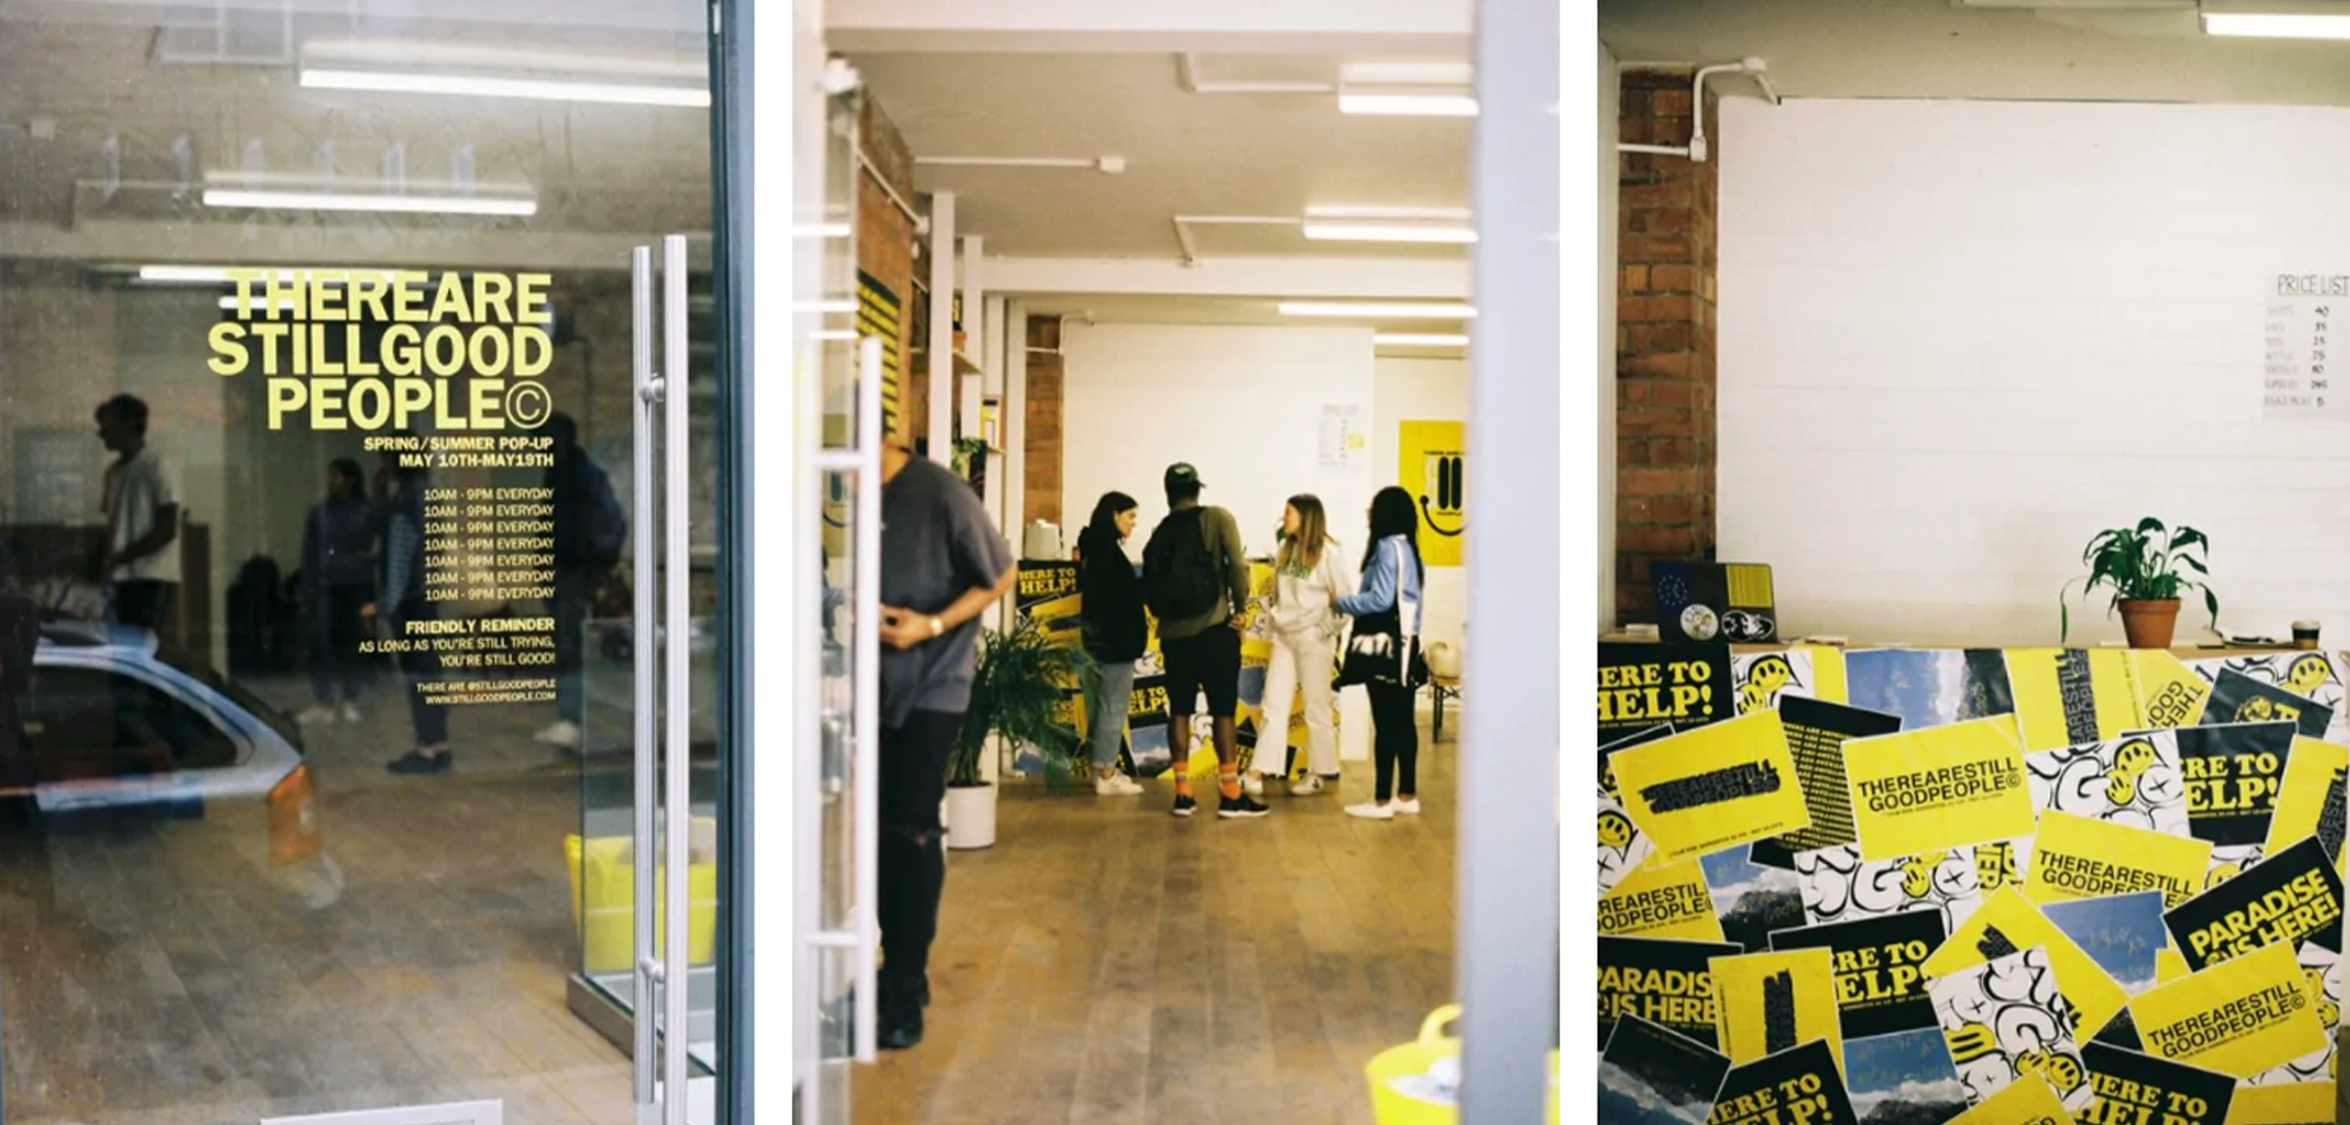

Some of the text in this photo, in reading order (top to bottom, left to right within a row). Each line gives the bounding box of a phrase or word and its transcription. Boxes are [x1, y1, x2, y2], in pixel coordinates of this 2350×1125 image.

[2278, 274, 2317, 295] PRICE
[224, 269, 552, 324] THEREARE
[207, 321, 553, 376] STILLGOOD
[363, 435, 554, 452] SPRING/SUMMER POP-UP
[399, 452, 554, 468] MAY 10TH-MAY19TH
[424, 489, 457, 500] 10AM
[467, 488, 493, 500] 9PM
[496, 488, 555, 499] EVERYDAY
[424, 506, 457, 517] 10AM
[467, 505, 493, 516] 9PM
[496, 504, 555, 516] EVERYDAY
[424, 522, 457, 533] 10AM
[467, 522, 493, 533] 9PM
[496, 521, 555, 532] EVERYDAY
[425, 539, 458, 550] 10AM
[468, 538, 494, 549] 9PM
[497, 538, 556, 549] EVERYDAY
[425, 556, 458, 567] 10AM
[468, 555, 494, 566] 9PM
[497, 554, 556, 566] EVERYDAY
[425, 572, 458, 583] 10AM
[468, 572, 494, 583] 9PM
[497, 571, 556, 582] EVERYDAY
[1058, 567, 1077, 578] TO
[425, 589, 458, 600] 10AM
[468, 588, 494, 599] 9PM
[497, 588, 556, 599] EVERYDAY
[1020, 577, 1077, 594] HELP!
[405, 617, 555, 635] FRIENDLY REMINDER
[358, 641, 375, 653] AS
[377, 640, 411, 653] LONG
[413, 639, 429, 651] AS
[432, 638, 474, 650] YOU'RE
[477, 637, 508, 649] STILL
[439, 652, 555, 667] YOU'RE STILL GOOD!
[1598, 660, 1711, 687] ERE TO
[2180, 752, 2278, 779] RE TO
[1857, 757, 2019, 798] THEREARESTILL
[2039, 850, 2194, 896] THEREARESTILL
[1598, 897, 1712, 931] ODPEOPLE
[2188, 867, 2330, 958] PARADISE
[2257, 892, 2341, 946] HERE!
[1833, 940, 1928, 972] RE TO
[1598, 965, 1712, 997] ARADIS
[2148, 981, 2301, 1046] THEREARESTILL
[1780, 1073, 1821, 1100] TO
[2167, 1090, 2208, 1118] TO
